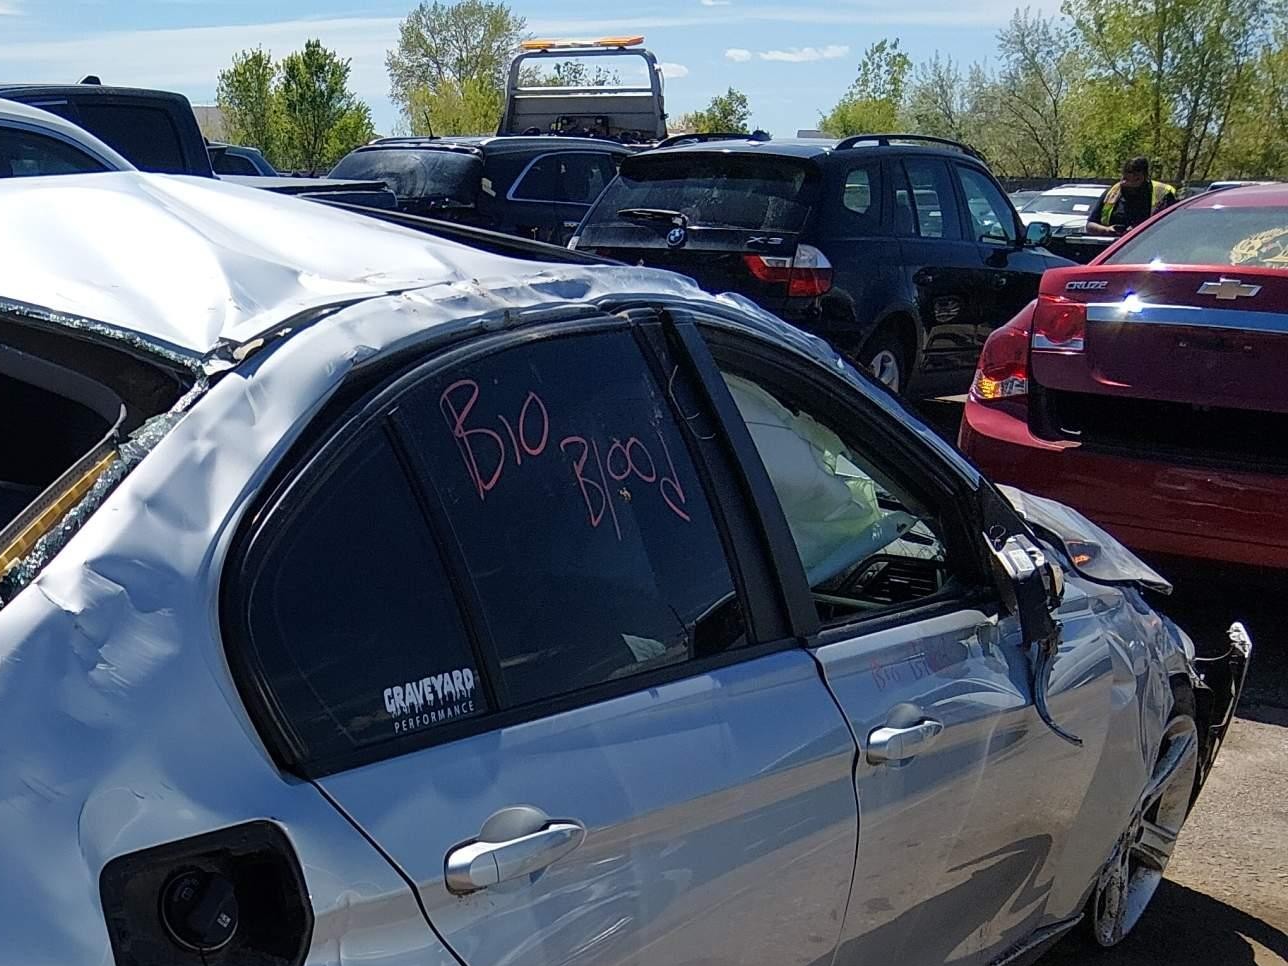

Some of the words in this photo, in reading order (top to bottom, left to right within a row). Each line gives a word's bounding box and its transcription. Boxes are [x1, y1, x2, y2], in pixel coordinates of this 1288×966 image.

[1065, 281, 1109, 290] CRUZE
[383, 667, 475, 718] GRAVEYARD
[394, 700, 475, 734] PERFORMANCE
